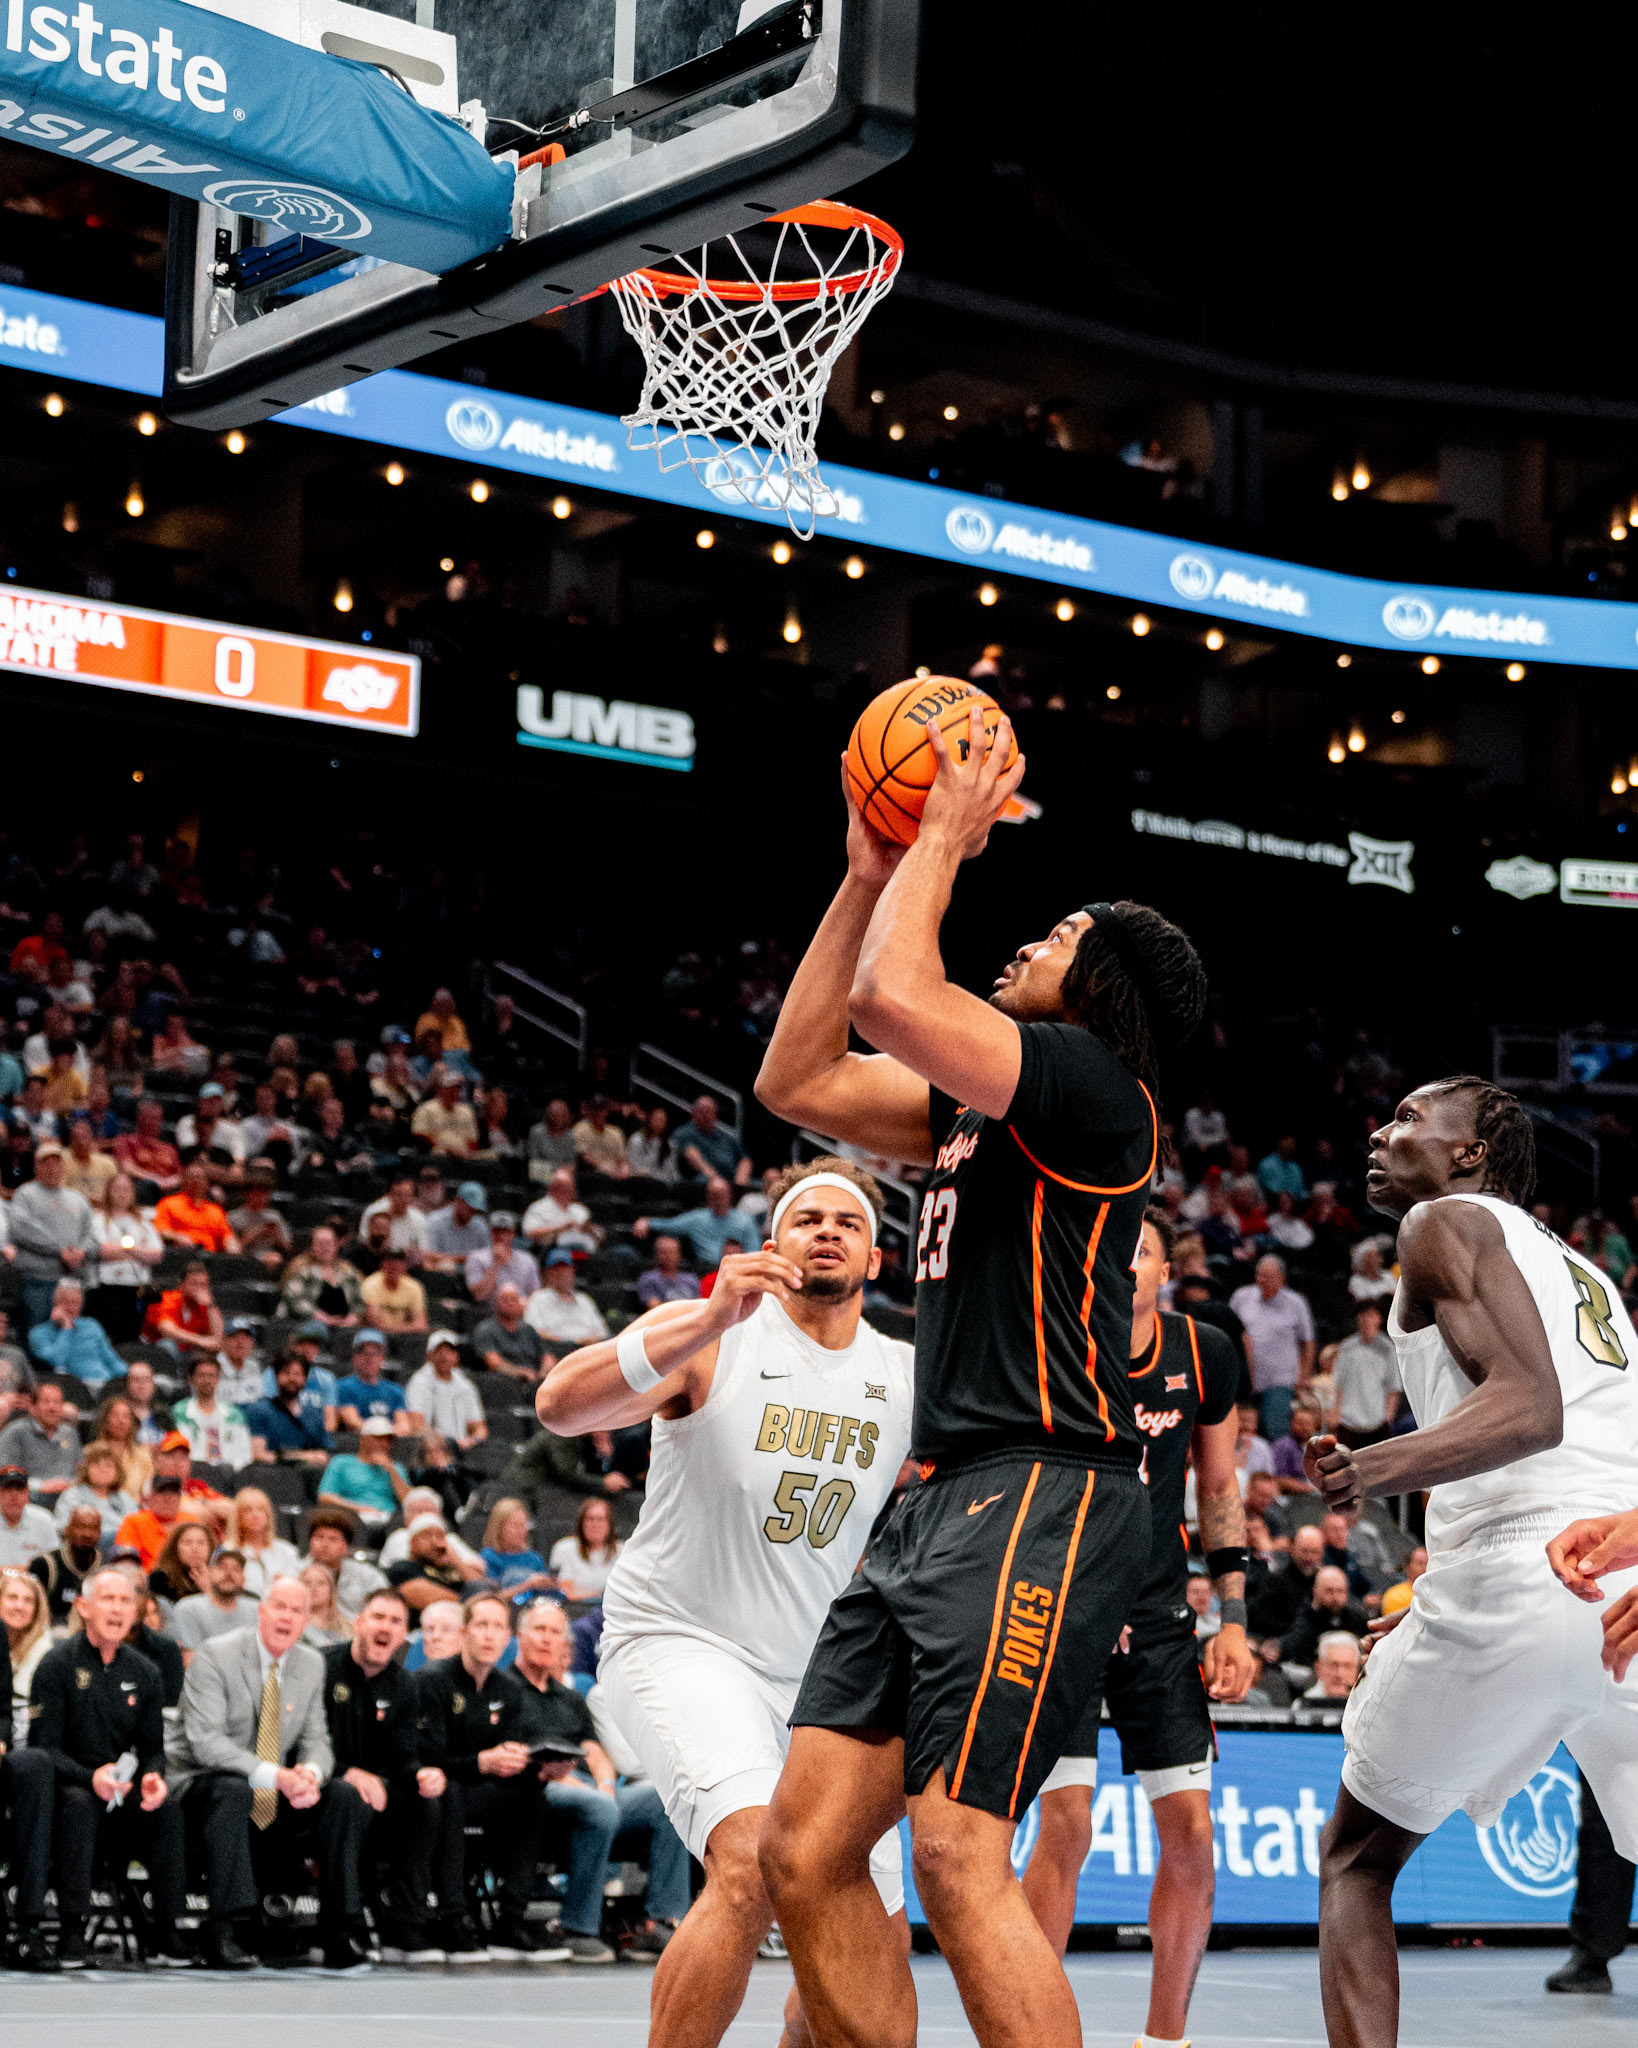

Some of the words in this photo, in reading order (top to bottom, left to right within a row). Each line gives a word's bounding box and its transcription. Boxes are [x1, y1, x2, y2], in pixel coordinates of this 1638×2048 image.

[500, 418, 616, 471] Allstate
[214, 636, 256, 698] 0
[516, 683, 696, 758] UMB
[914, 1186, 958, 1284] 23
[1561, 1253, 1629, 1372] 8
[755, 1402, 880, 1470] BUFFS
[763, 1470, 857, 1549] 50
[996, 1580, 1054, 1690] POKES
